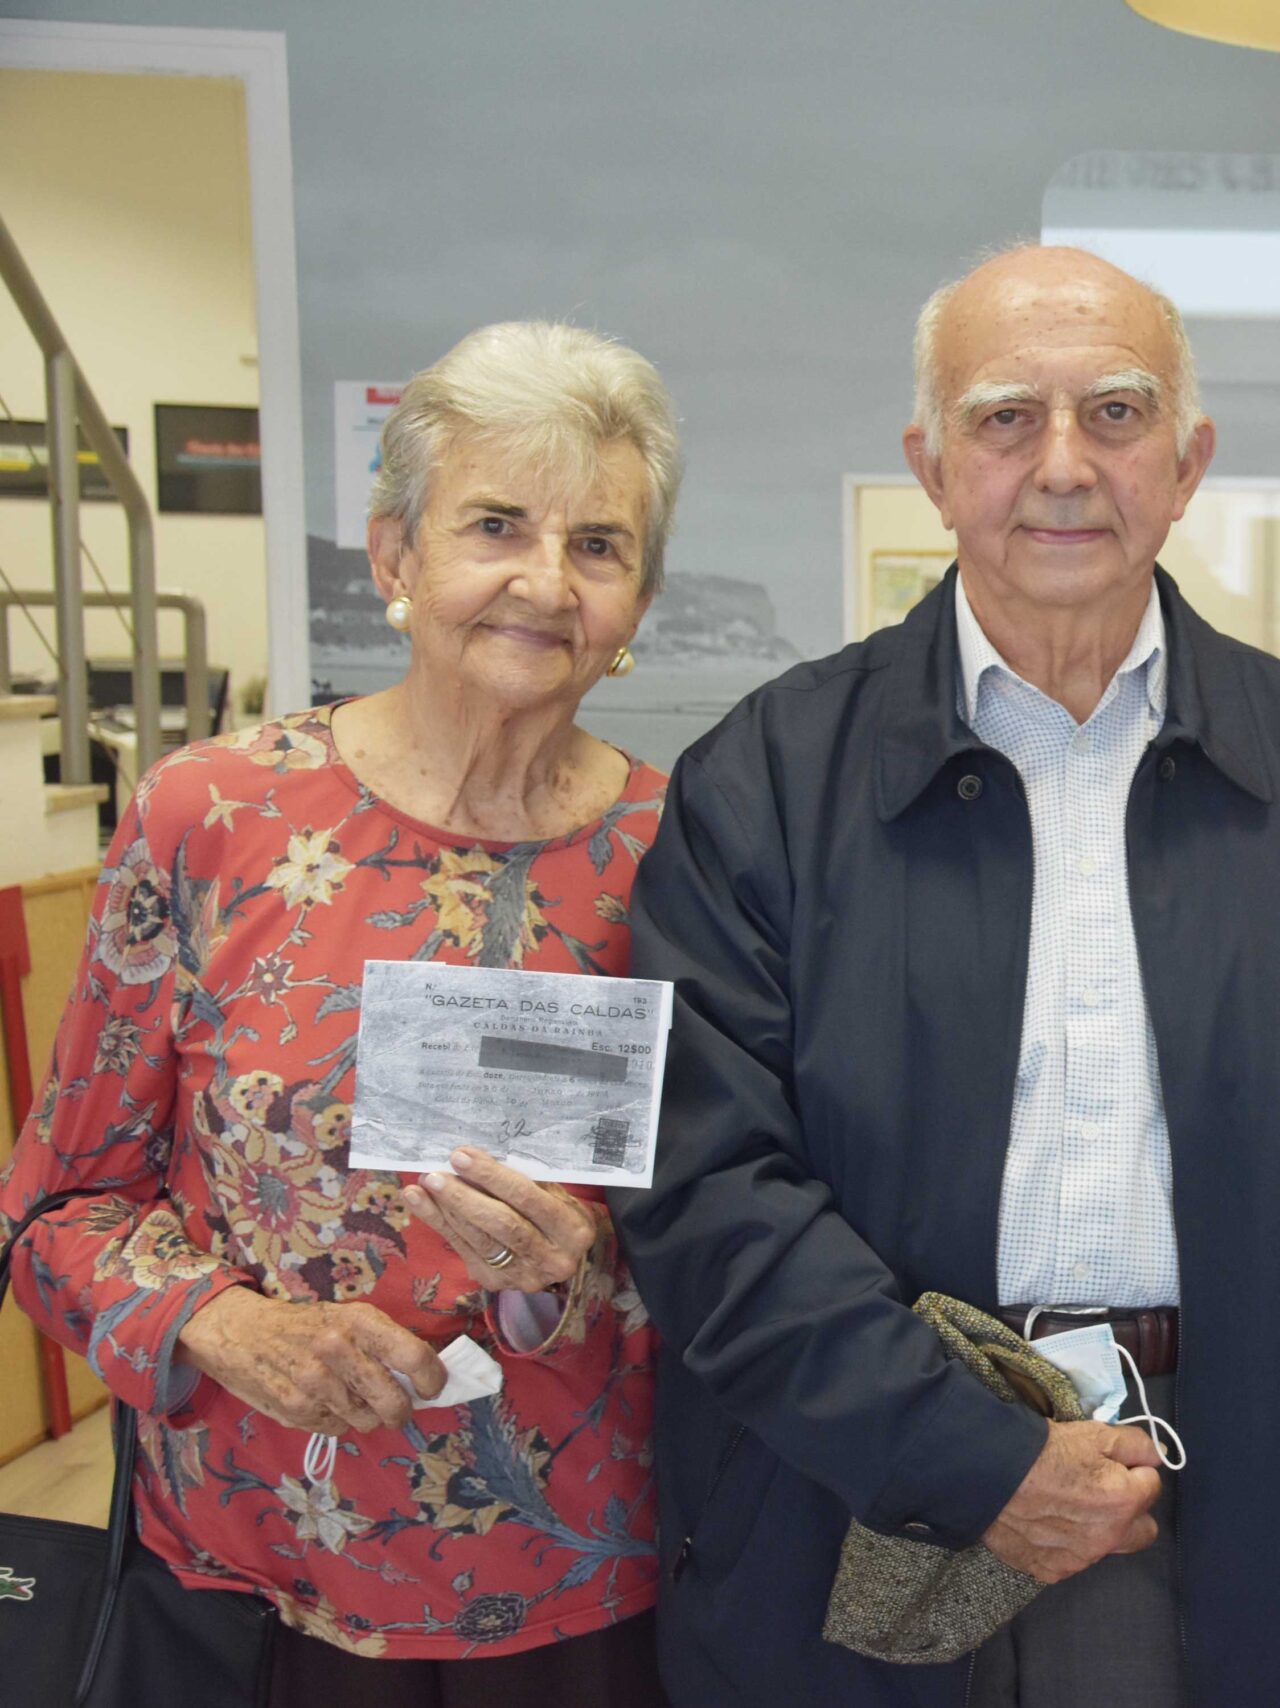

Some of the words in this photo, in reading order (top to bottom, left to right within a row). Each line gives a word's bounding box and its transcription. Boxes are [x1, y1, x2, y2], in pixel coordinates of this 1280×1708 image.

[520, 1000, 559, 1014] DAS
[473, 1021, 526, 1032] CALDAS
[531, 1026, 548, 1034] DA
[553, 1027, 603, 1038] RAINHA
